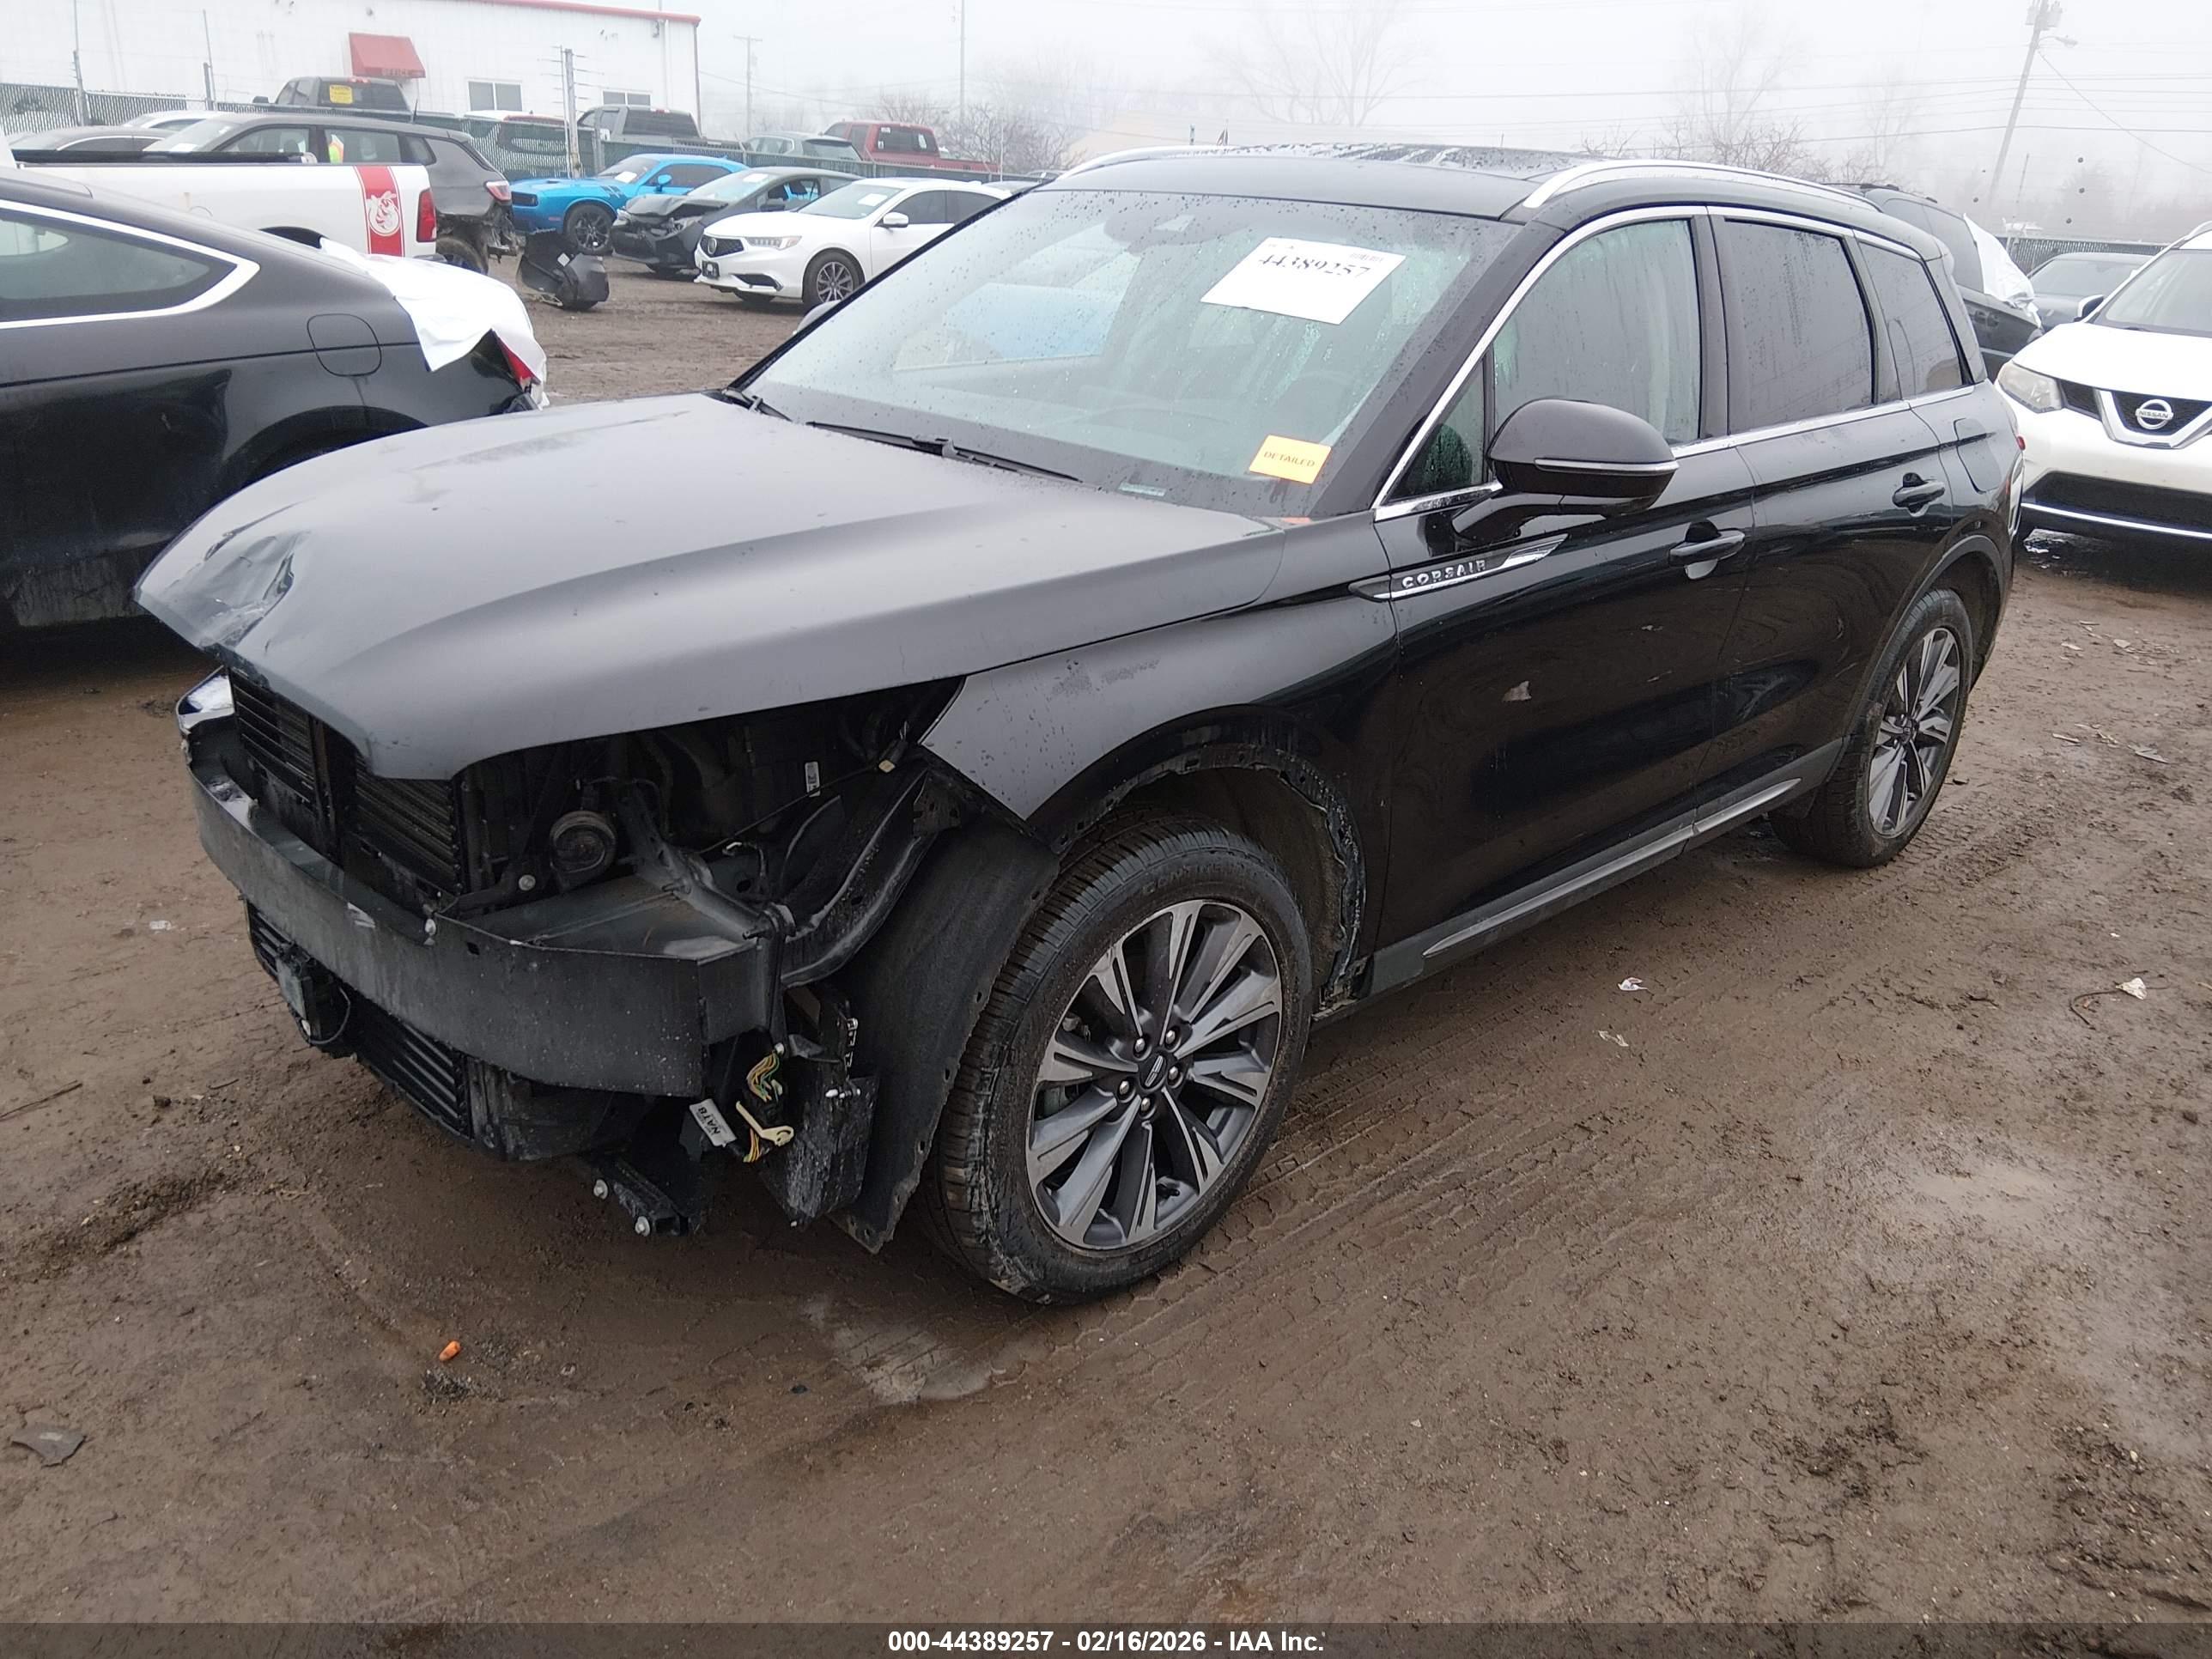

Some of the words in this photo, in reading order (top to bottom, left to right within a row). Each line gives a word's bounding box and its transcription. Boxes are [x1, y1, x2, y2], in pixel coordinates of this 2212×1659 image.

[1259, 254, 1370, 277] 44389257
[2138, 410, 2170, 419] NISSAN
[1263, 451, 1316, 467] DETAILED
[1401, 559, 1486, 589] CORSAIR
[697, 1106, 721, 1135] NATB
